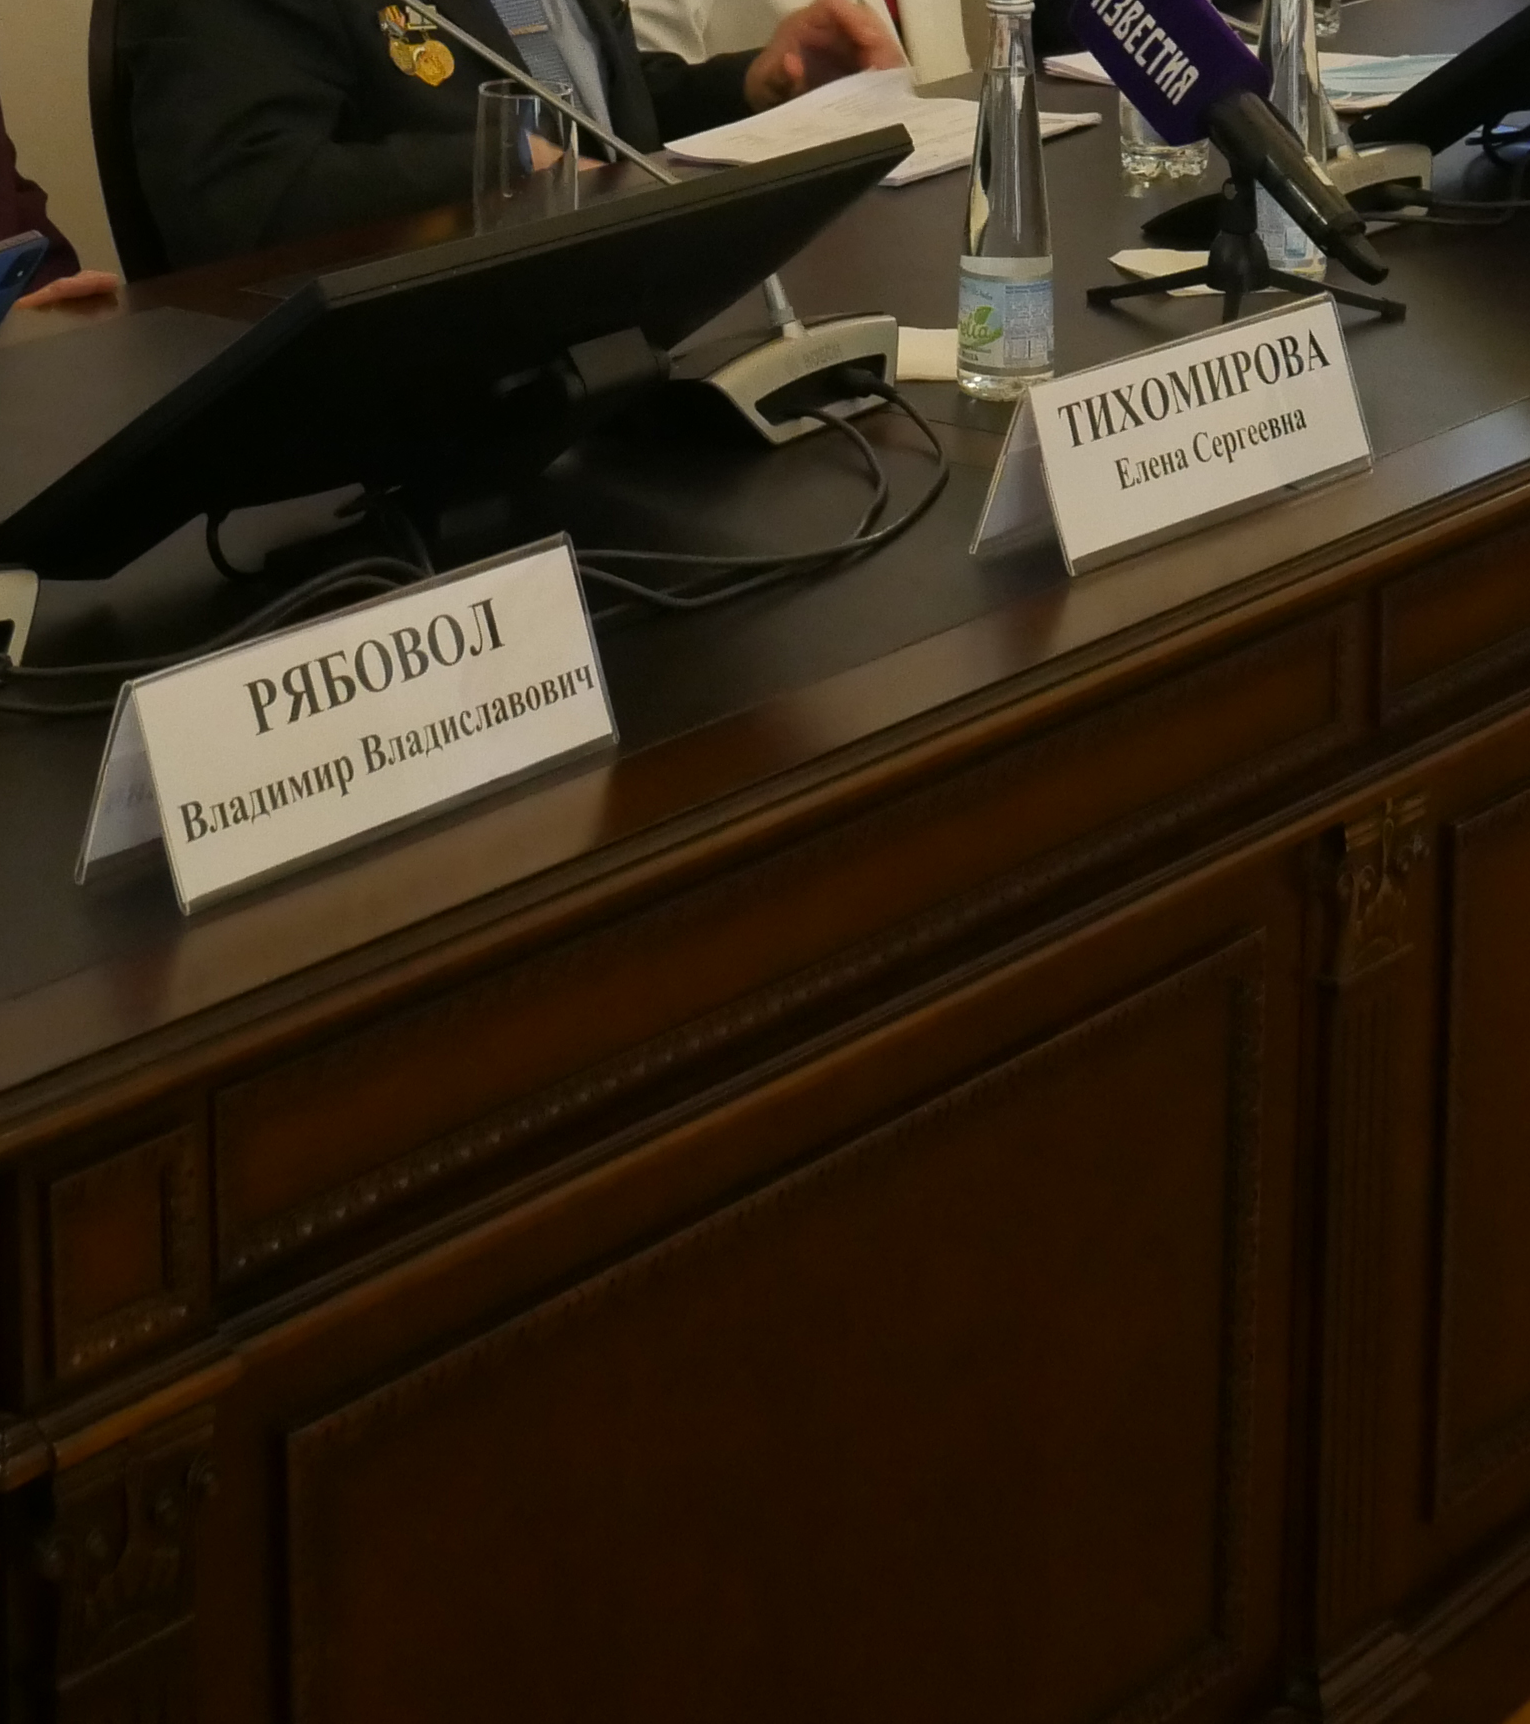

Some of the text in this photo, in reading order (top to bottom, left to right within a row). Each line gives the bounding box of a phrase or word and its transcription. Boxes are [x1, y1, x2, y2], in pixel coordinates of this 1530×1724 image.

[1057, 328, 1331, 448] ТИХОМИРОВА
[1114, 408, 1308, 491] Елена Сергеевна
[244, 597, 505, 736] РЯБОВОЛ
[179, 664, 596, 843] Владимир Владиславович
